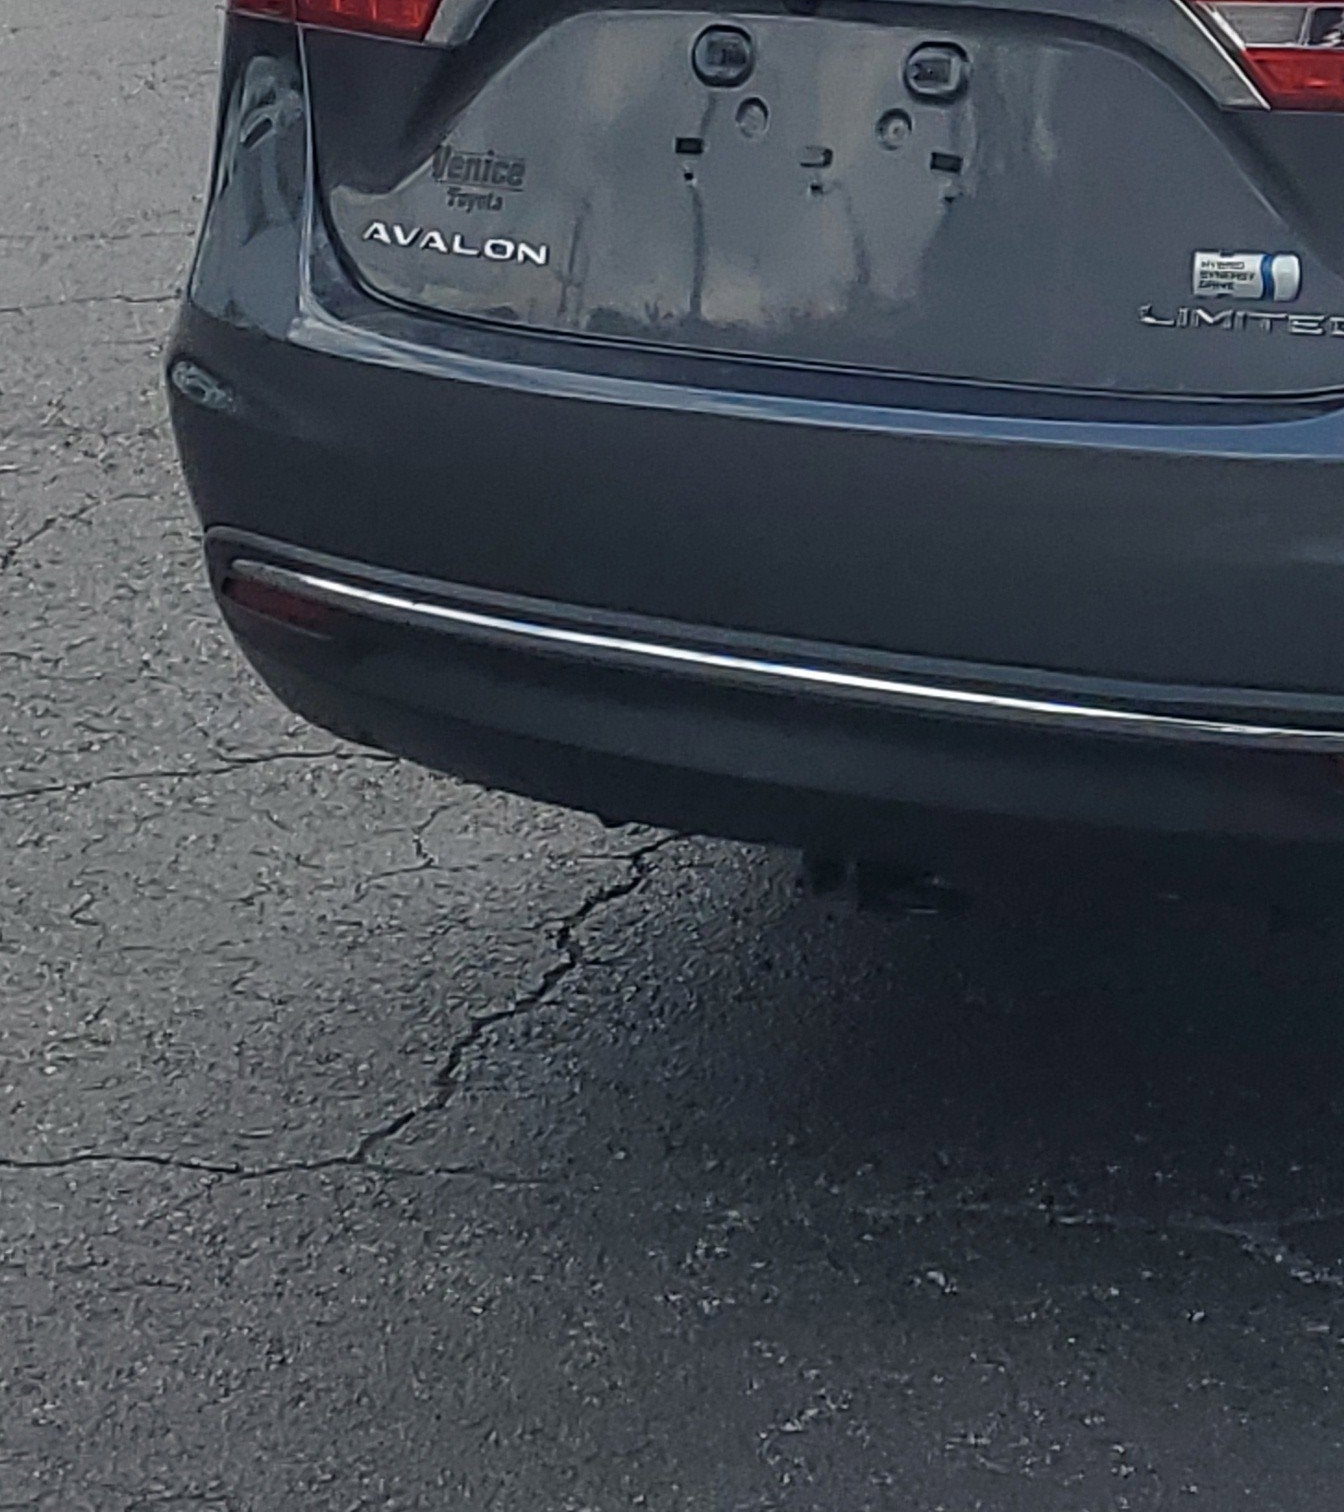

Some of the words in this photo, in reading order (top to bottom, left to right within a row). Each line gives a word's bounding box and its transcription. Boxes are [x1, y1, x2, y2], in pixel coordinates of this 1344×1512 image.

[432, 145, 526, 186] Venice
[447, 187, 503, 214] Toyota
[363, 221, 548, 265] AVALON
